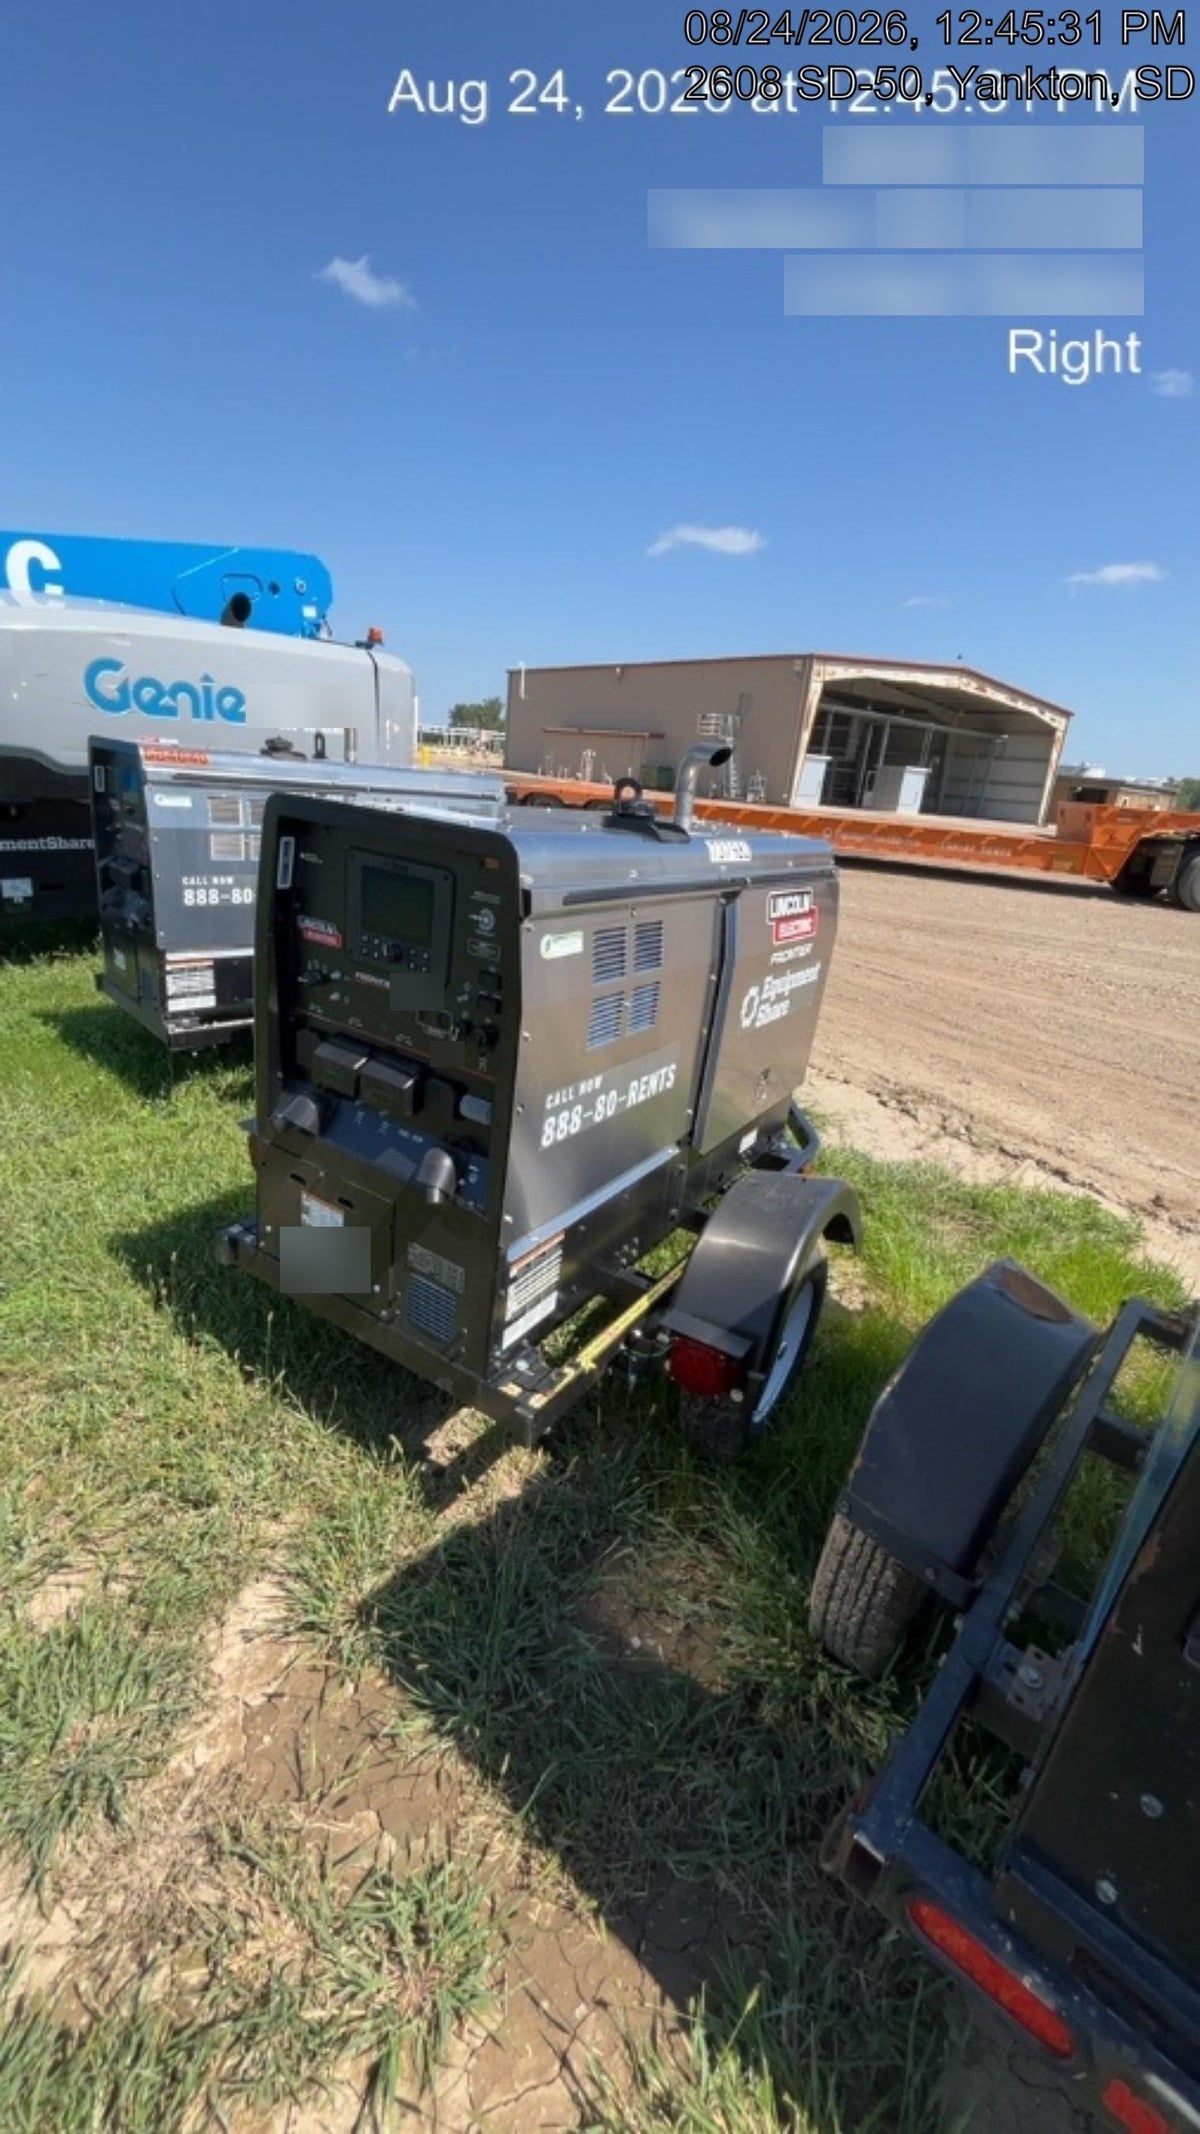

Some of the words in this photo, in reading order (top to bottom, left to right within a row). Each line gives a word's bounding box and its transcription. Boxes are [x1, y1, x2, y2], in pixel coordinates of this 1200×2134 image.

[84, 657, 247, 727] Genie
[182, 876, 208, 886] CALL
[770, 893, 811, 918] LINCOLN
[761, 963, 821, 1001] Equipment
[756, 1000, 790, 1028] Share
[541, 1062, 677, 1148] 888-80-RENTS
[545, 1086, 575, 1110] CALL
[578, 1074, 603, 1096] NOW
